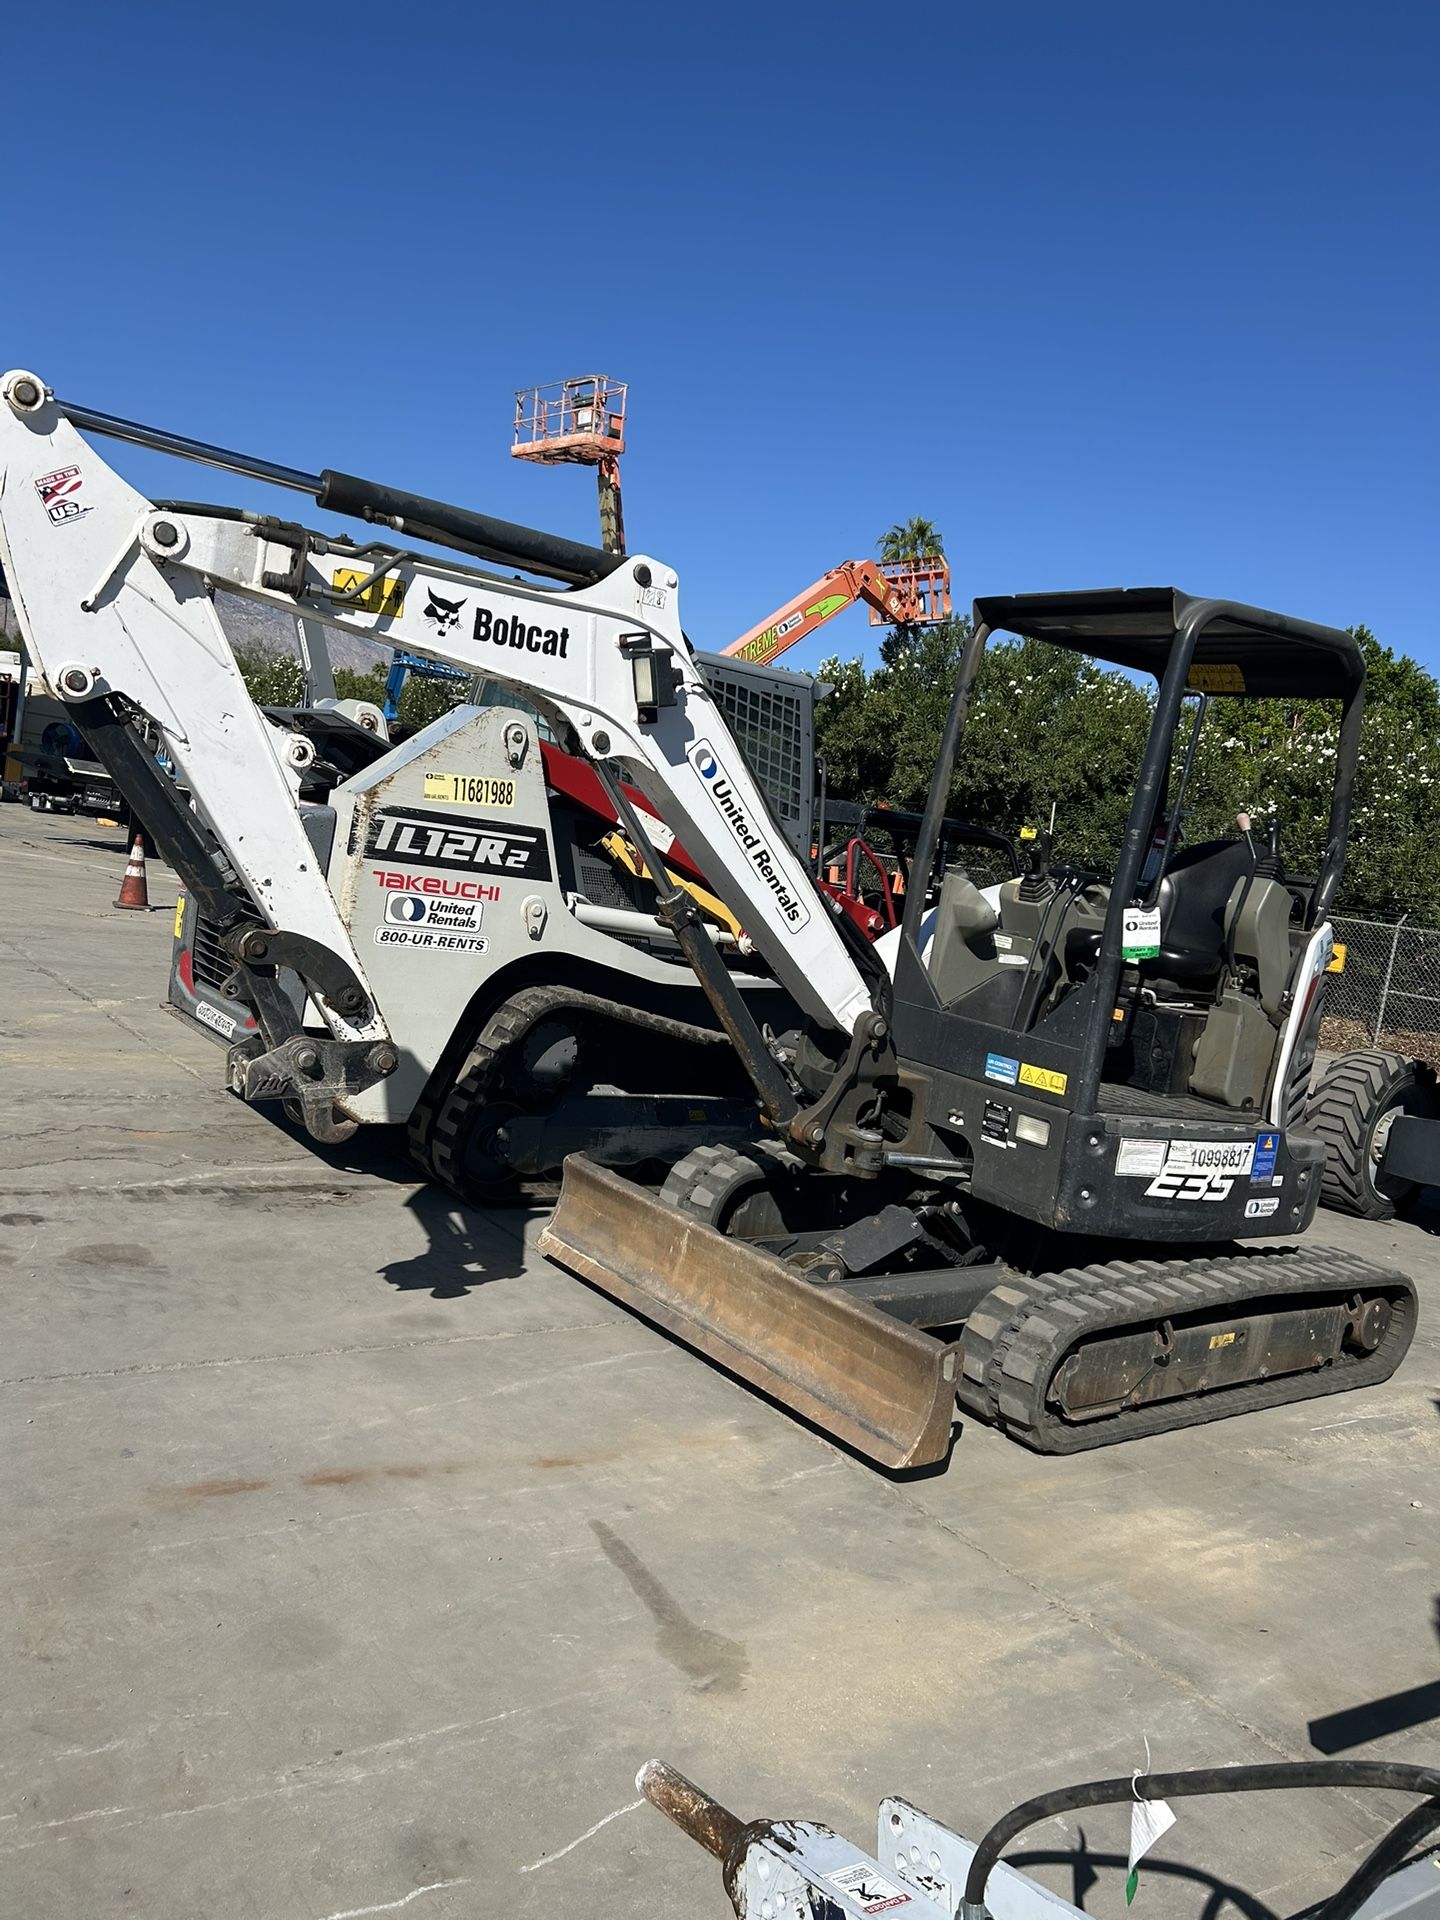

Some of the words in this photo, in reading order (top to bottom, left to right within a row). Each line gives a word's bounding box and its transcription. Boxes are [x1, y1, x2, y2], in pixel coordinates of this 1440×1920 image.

[36, 475, 56, 486] MADE
[64, 469, 77, 477] THE
[50, 503, 80, 520] US
[473, 607, 570, 659] Bobcat
[453, 777, 513, 805] 11681988
[374, 814, 537, 869] TL12R2
[712, 779, 761, 850] United
[753, 849, 800, 922] Rentals
[373, 870, 501, 902] TAKEUCHI
[429, 900, 476, 916] United
[427, 913, 477, 929] Rentals
[380, 930, 485, 951] 800-UR-RENTS
[1191, 1149, 1250, 1168] 10998817
[1144, 1174, 1235, 1201] E35
[866, 1898, 902, 1914] DANGER
